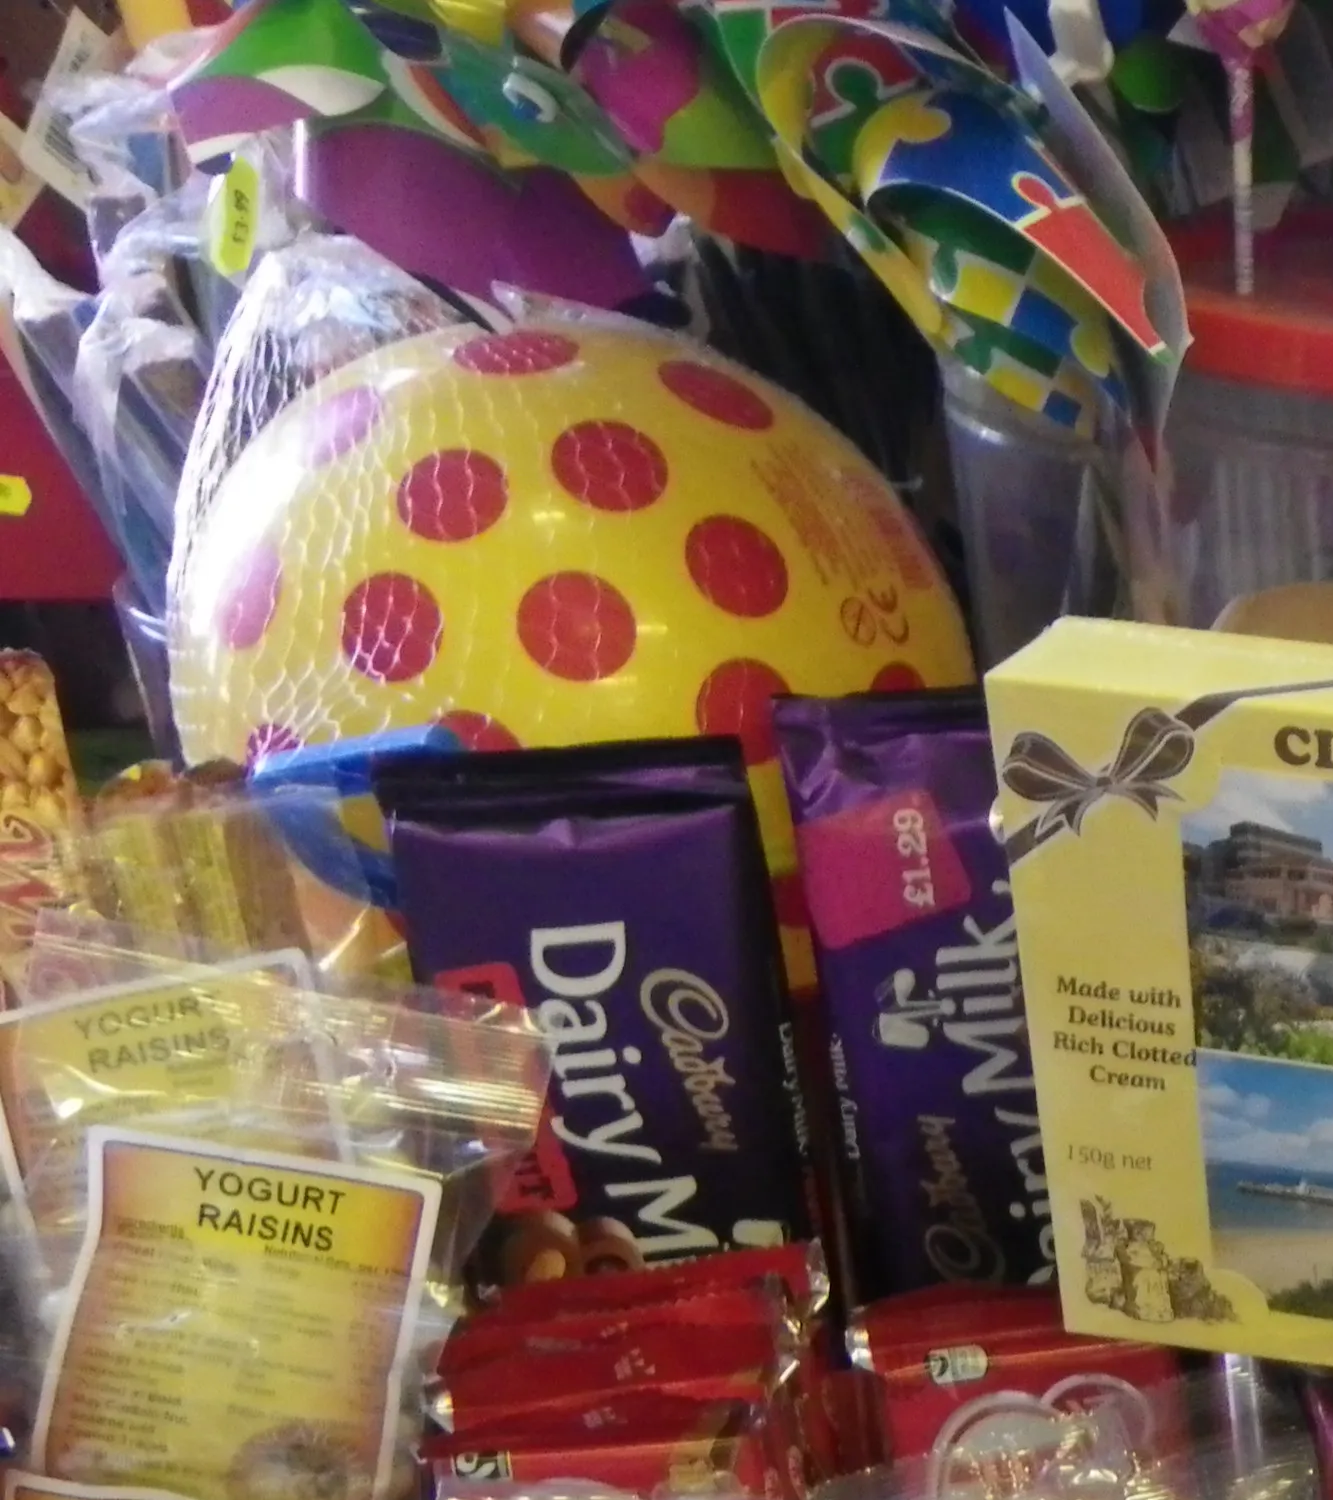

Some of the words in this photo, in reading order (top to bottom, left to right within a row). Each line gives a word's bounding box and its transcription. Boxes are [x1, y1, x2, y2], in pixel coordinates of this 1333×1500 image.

[892, 807, 936, 908] £1.29
[1056, 975, 1121, 1000] Made
[1128, 986, 1182, 1009] with
[529, 920, 662, 1166] Dairy
[1068, 1005, 1176, 1037] Delicious
[88, 1024, 231, 1074] RAISINS
[640, 967, 739, 1151] Cadbury
[1053, 1031, 1104, 1056] Rich
[1112, 1040, 1197, 1068] Clotted
[1089, 1064, 1166, 1091] Cream
[193, 1165, 346, 1216] YOGURT
[198, 1203, 334, 1252] RAISINS
